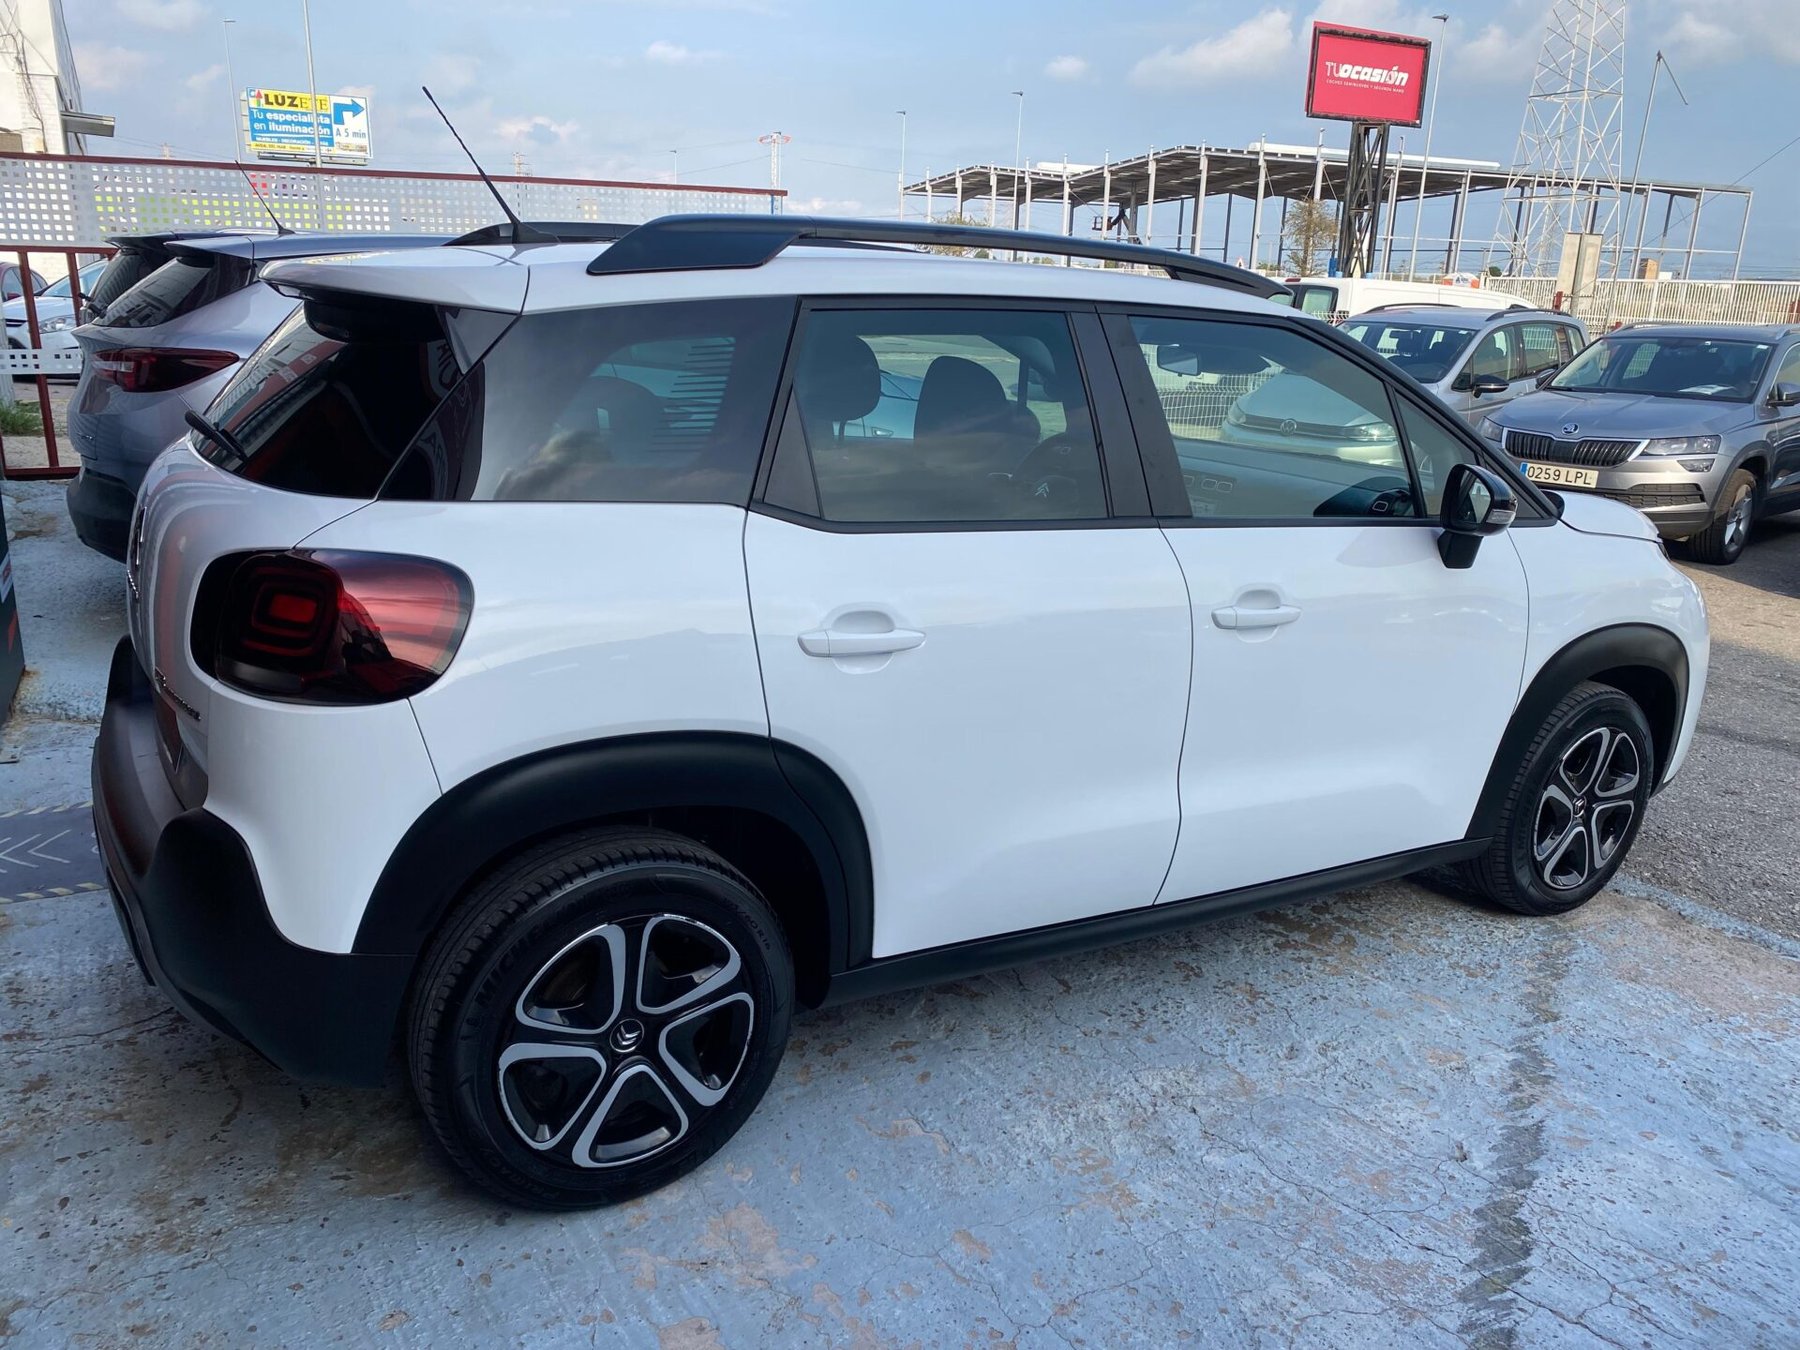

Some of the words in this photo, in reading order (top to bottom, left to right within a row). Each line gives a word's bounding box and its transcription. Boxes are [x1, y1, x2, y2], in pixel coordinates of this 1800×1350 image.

[252, 110, 263, 118] Tu
[266, 112, 330, 124] especialita
[269, 122, 330, 135] iluminacón
[335, 128, 341, 137] A
[344, 128, 349, 138] 5
[352, 129, 366, 139] min
[1527, 466, 1560, 480] 0259
[1565, 470, 1591, 485] LPL
